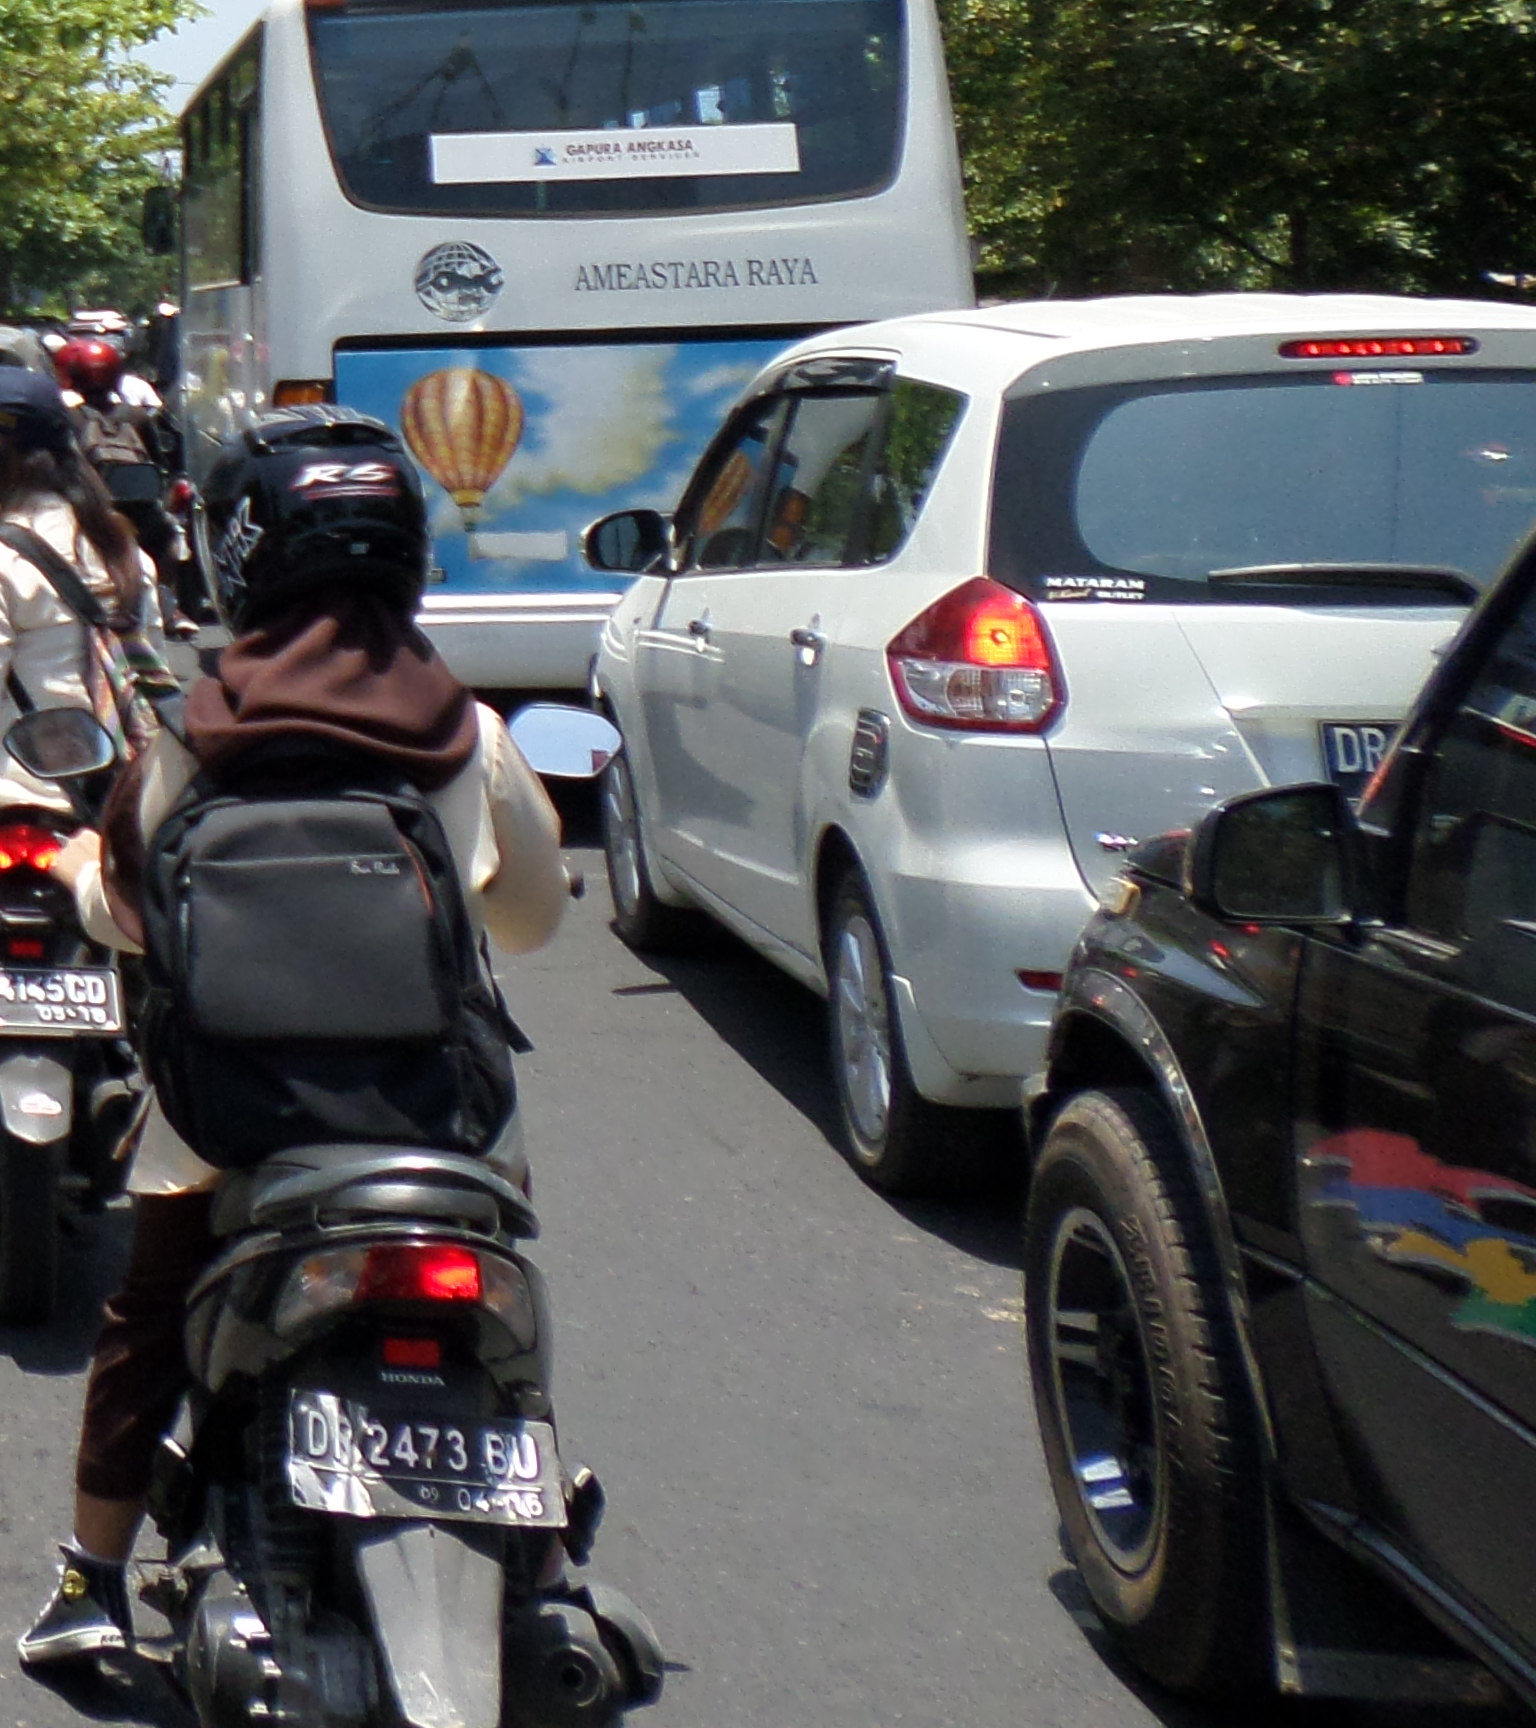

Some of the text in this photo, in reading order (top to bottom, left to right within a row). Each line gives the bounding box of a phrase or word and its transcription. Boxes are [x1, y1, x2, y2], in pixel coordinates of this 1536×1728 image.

[566, 139, 694, 156] GAPURA ANGKASA
[574, 258, 819, 292] AMEASTARA RAYA
[1333, 726, 1388, 773] DR
[380, 1371, 446, 1387] HONDA
[368, 1422, 469, 1472] 2473
